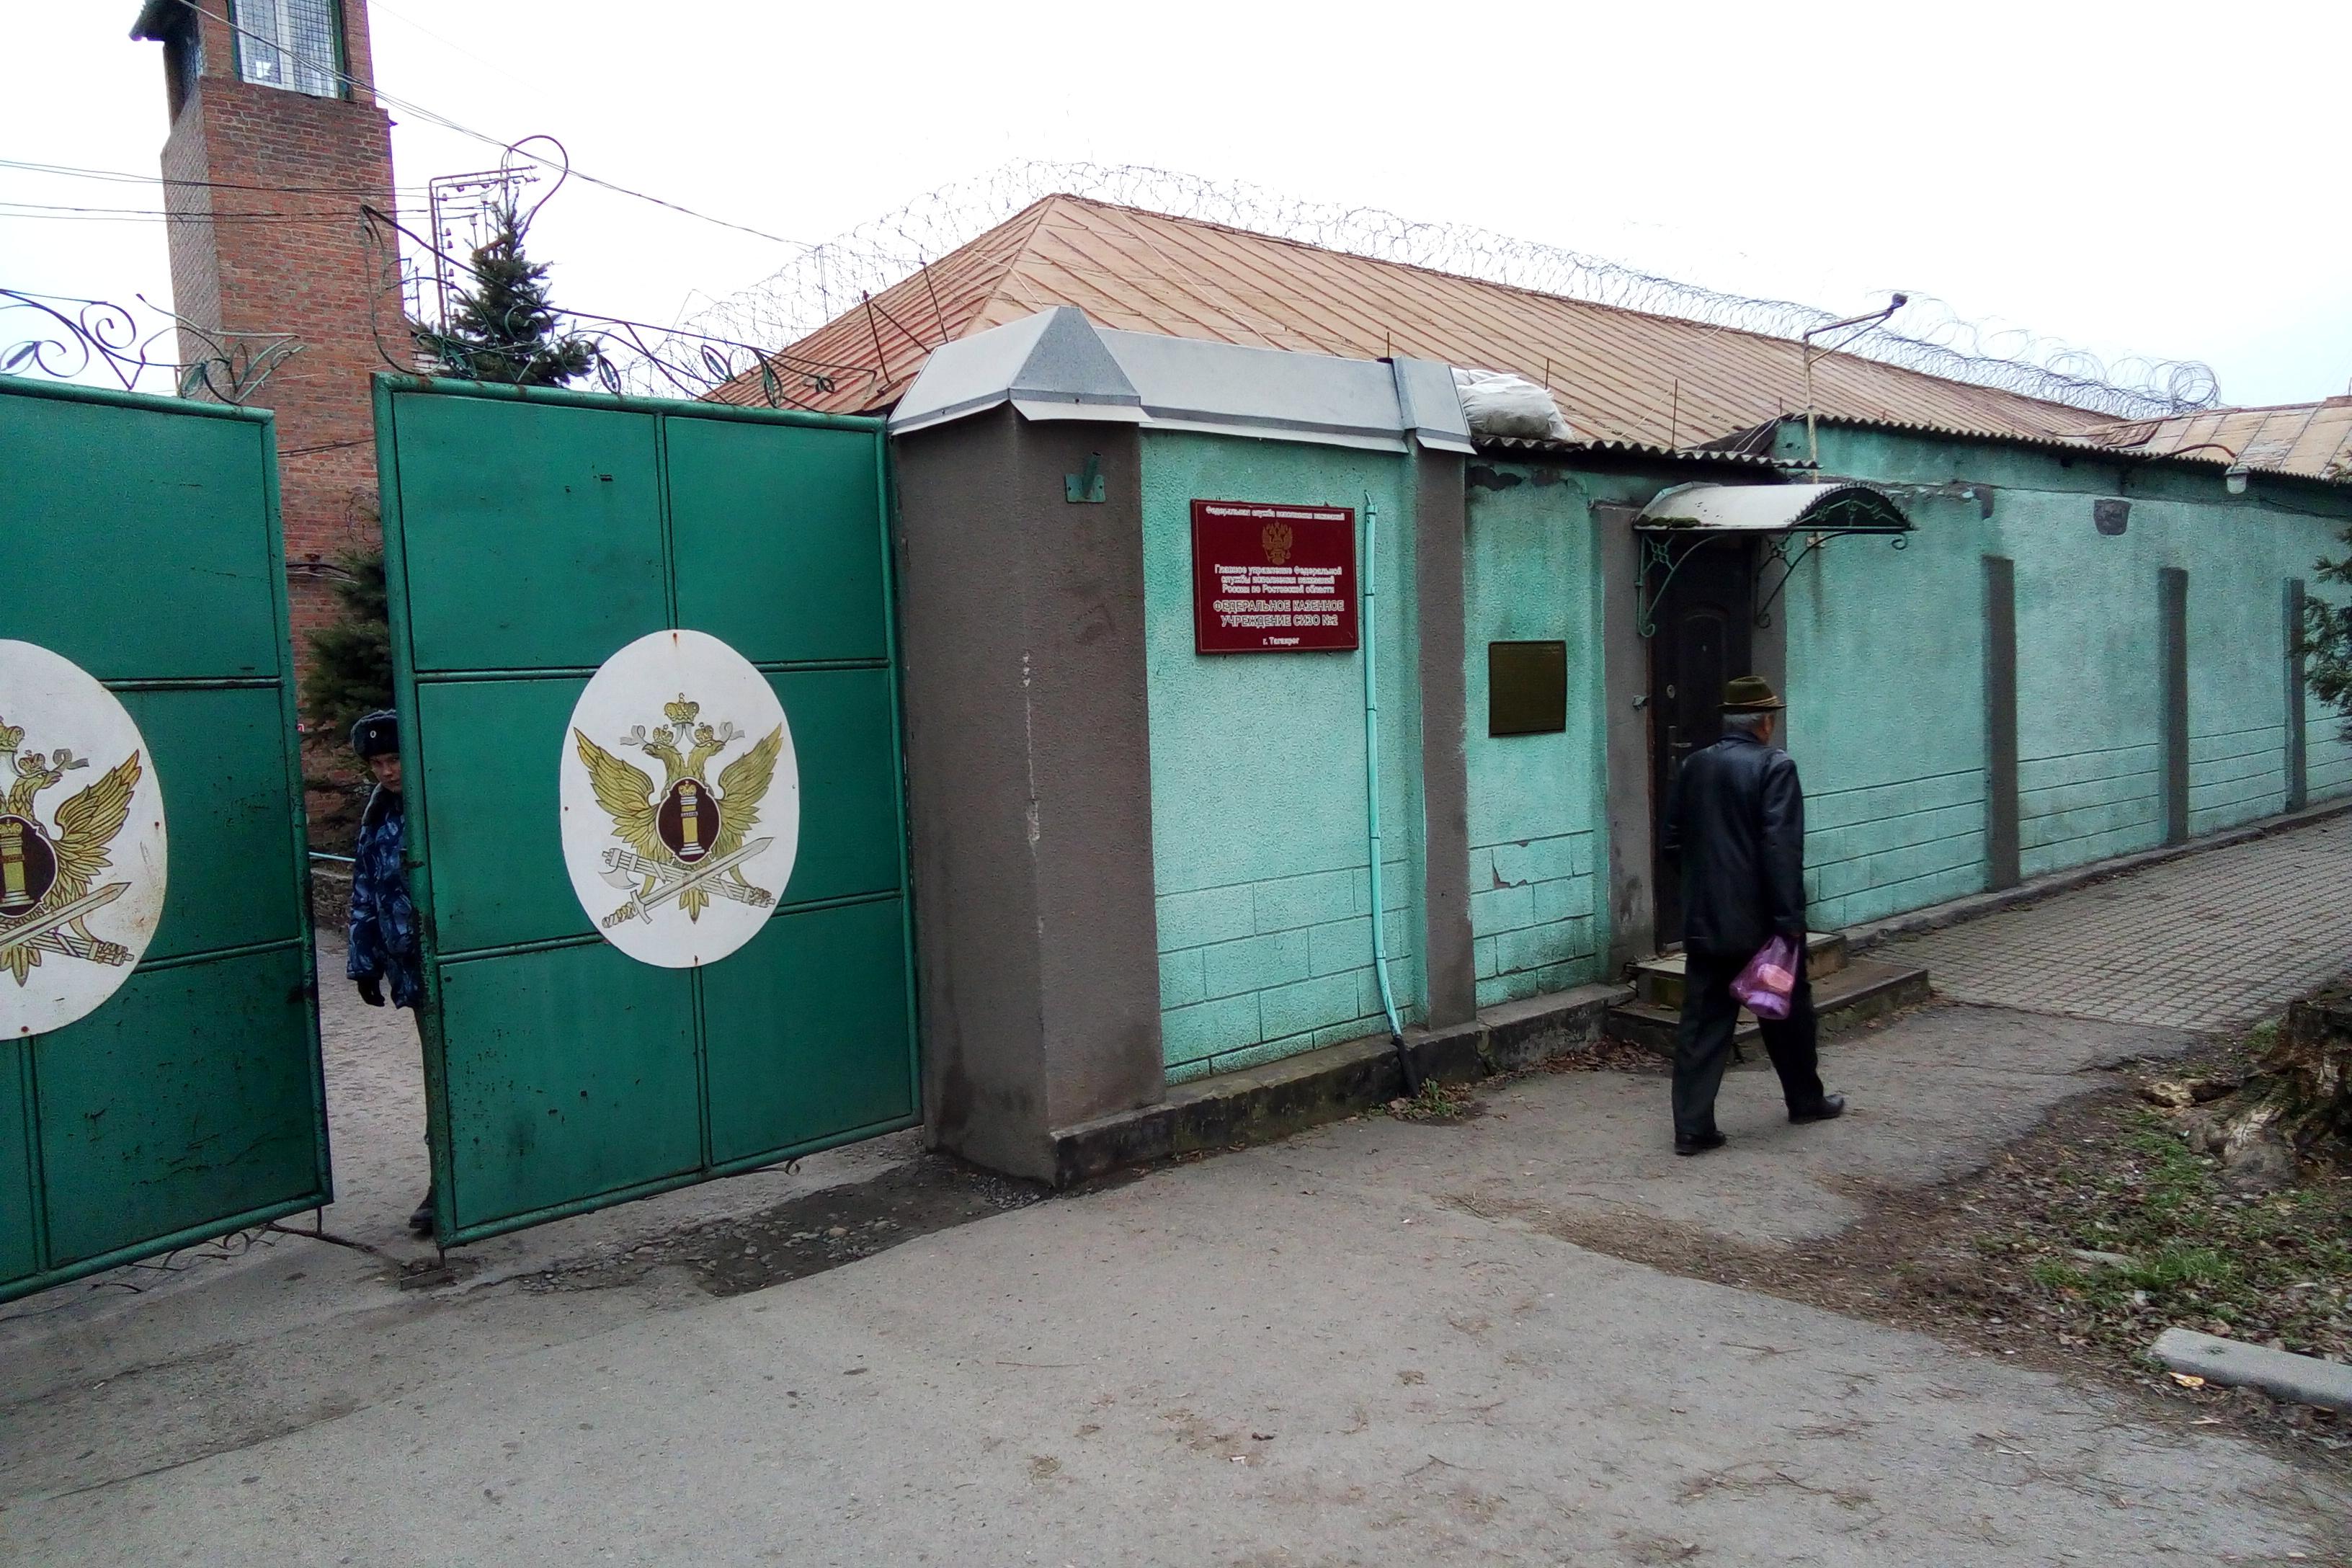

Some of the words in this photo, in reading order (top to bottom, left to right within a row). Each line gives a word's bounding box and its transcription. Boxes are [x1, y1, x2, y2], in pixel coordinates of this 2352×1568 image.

[1213, 600, 1291, 614] ФЕДЕРАЛЬНОЕ
[1293, 600, 1345, 612] КАЗЕННОЕ
[1220, 615, 1292, 628] УЧРЕЖДЕНИЕ
[1293, 615, 1321, 626] СИЗО
[1322, 615, 1339, 626] №2
